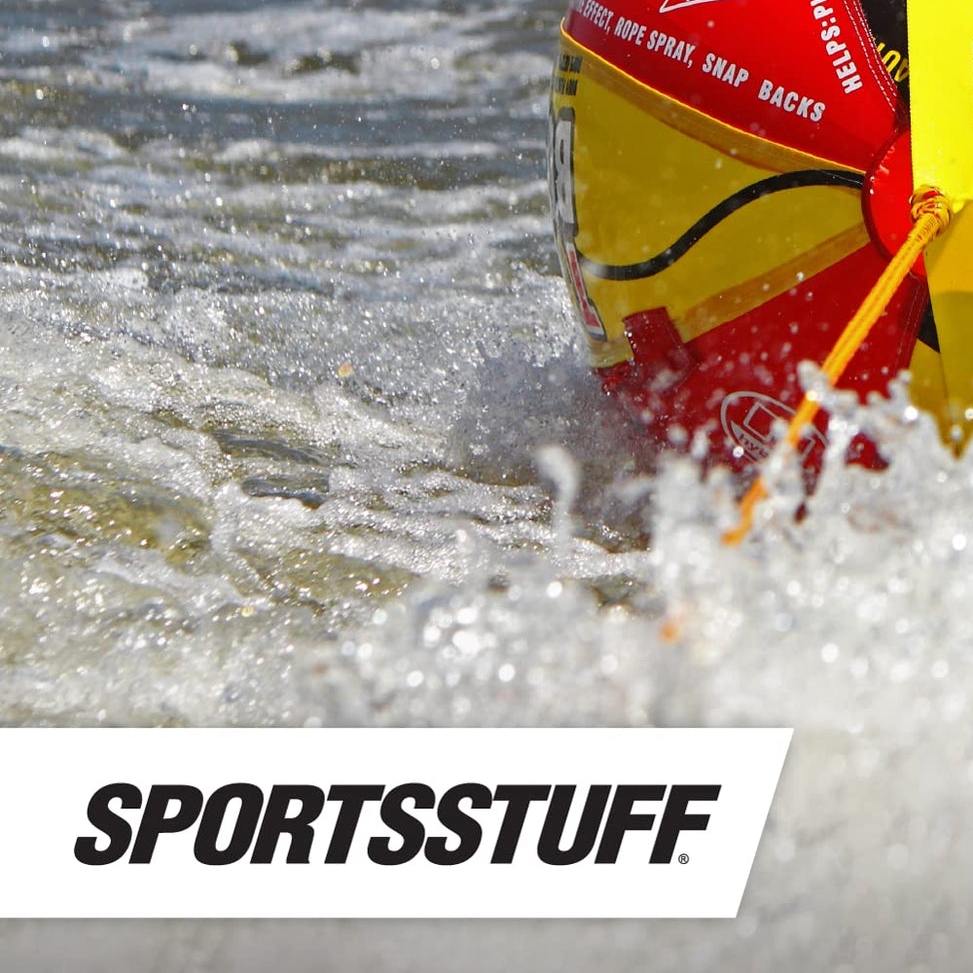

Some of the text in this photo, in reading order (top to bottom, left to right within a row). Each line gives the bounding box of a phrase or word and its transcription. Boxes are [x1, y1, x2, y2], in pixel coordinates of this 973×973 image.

[613, 17, 647, 46] ROPE
[646, 29, 696, 69] SPRAY,
[701, 52, 750, 88] SNAP
[757, 78, 826, 123] BACKS
